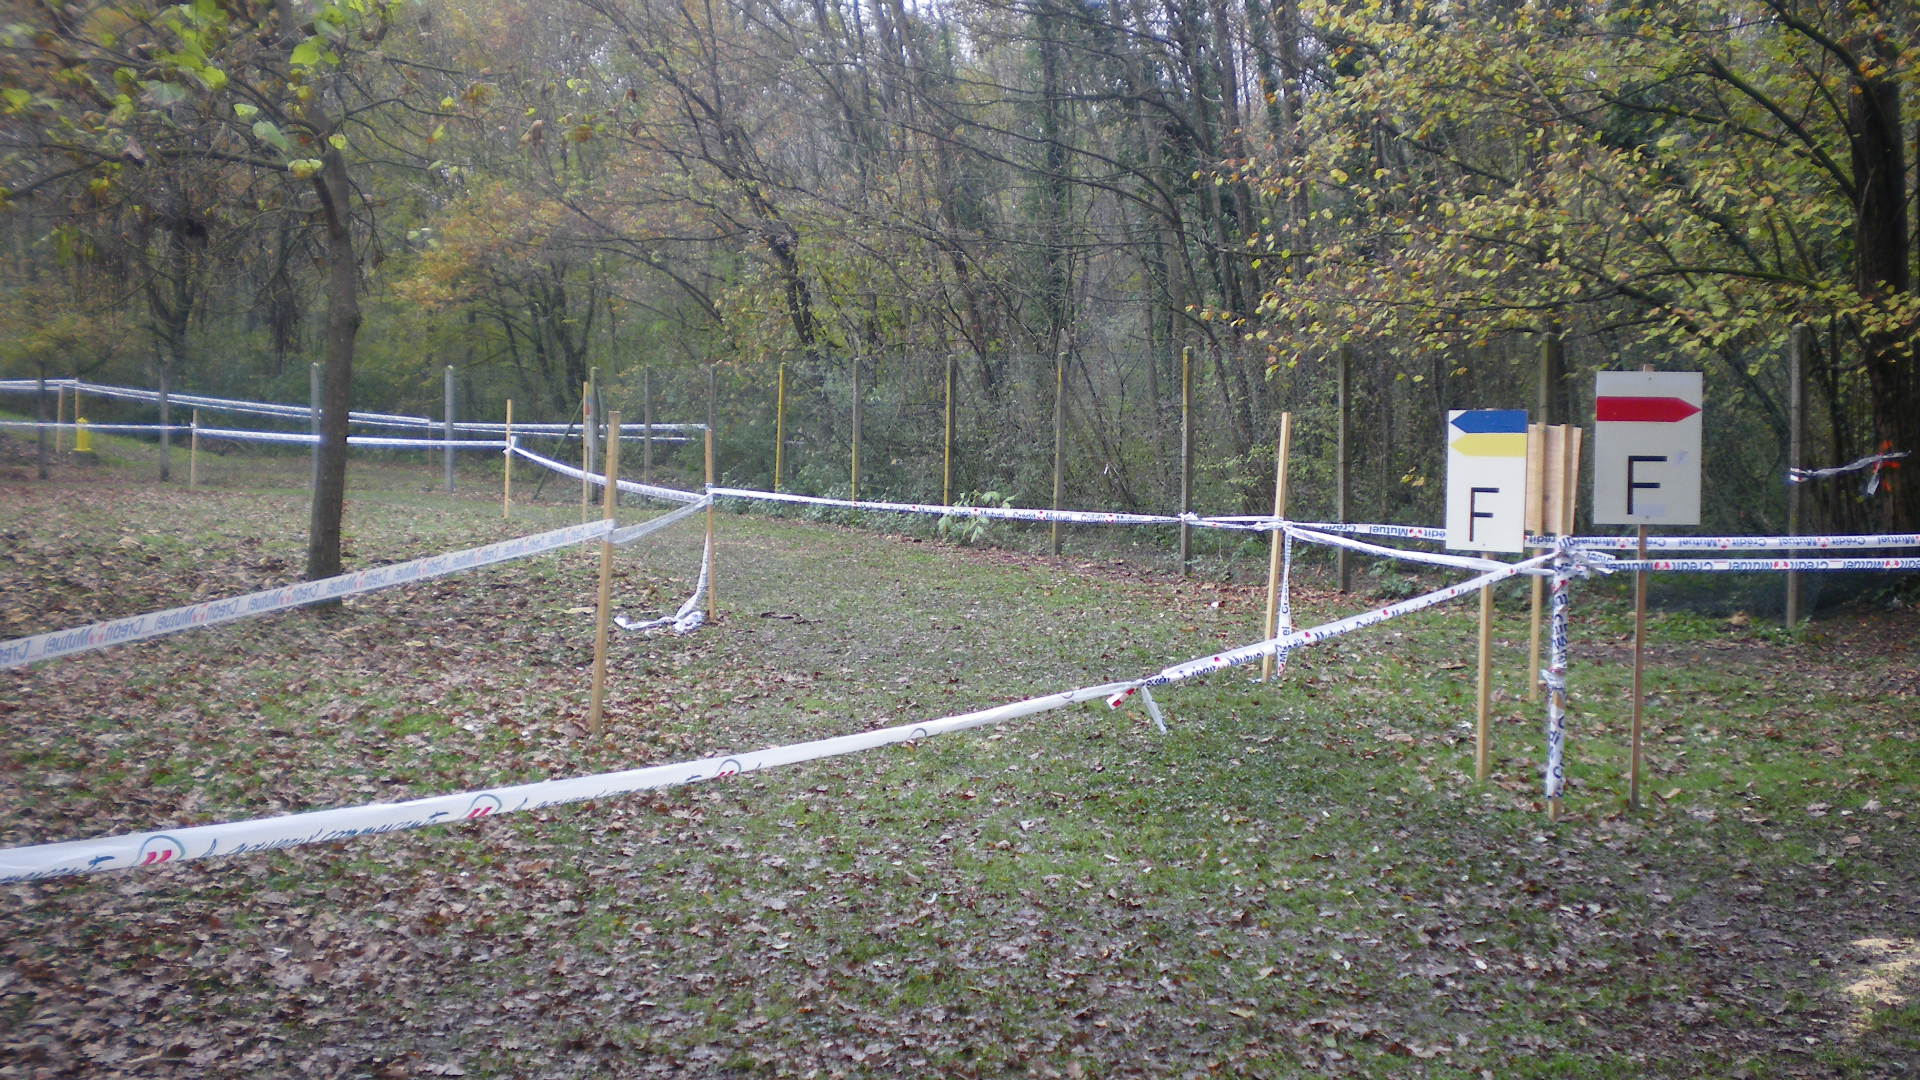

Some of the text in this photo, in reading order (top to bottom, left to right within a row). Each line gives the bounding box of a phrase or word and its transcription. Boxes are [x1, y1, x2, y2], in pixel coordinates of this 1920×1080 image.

[1627, 455, 1667, 514] F
[1369, 525, 1408, 537] Mutuel
[1469, 487, 1499, 542] F
